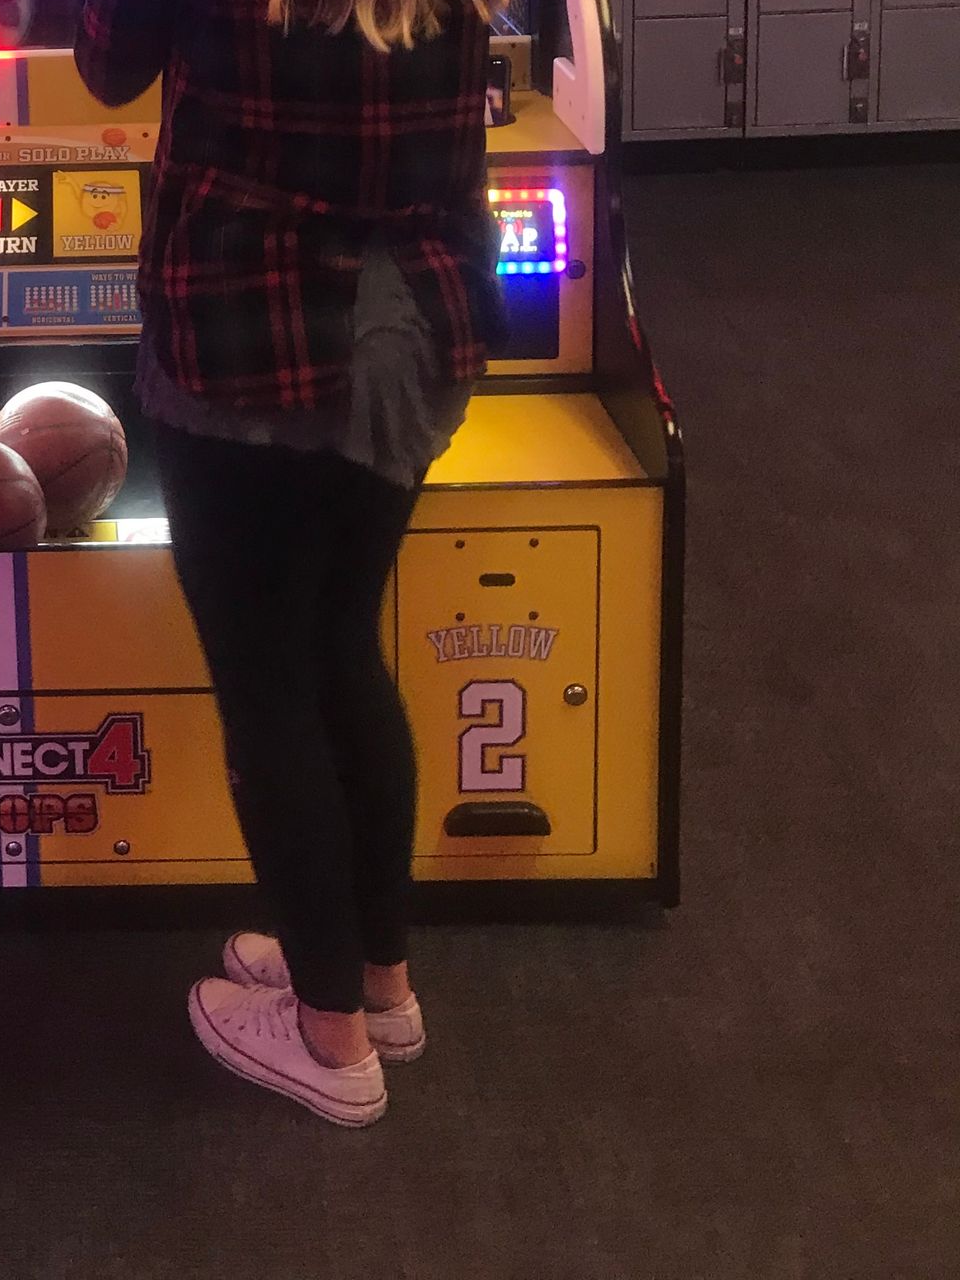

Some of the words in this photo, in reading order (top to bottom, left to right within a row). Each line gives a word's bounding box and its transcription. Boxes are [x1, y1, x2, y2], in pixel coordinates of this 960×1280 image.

[18, 147, 71, 162] SOLO
[75, 146, 130, 161] PLAY
[61, 234, 134, 251] YELLOW
[427, 625, 559, 664] YELLOW
[88, 721, 141, 786] 4
[458, 679, 526, 793] 2
